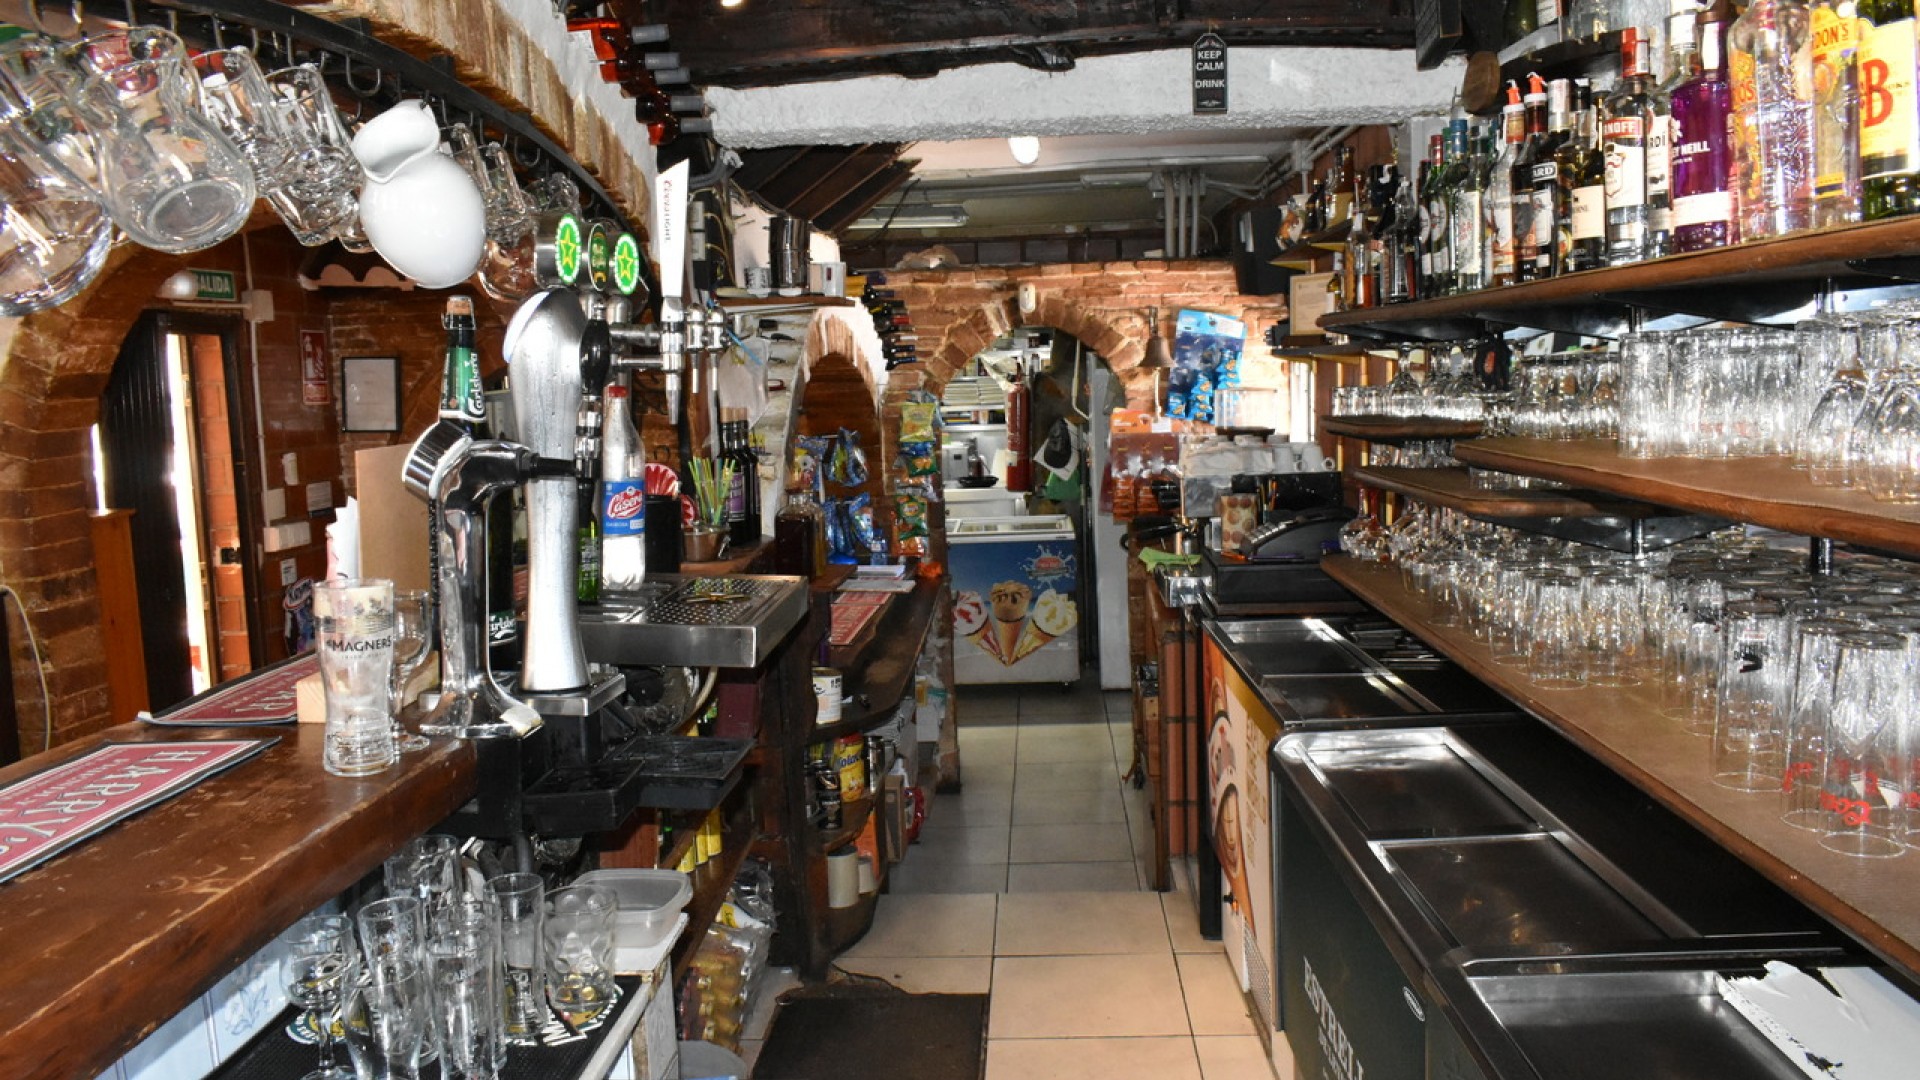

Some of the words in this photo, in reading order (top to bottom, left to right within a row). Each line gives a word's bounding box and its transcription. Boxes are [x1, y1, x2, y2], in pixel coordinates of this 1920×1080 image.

[1197, 50, 1222, 59] KEEP
[1196, 62, 1225, 71] CALM
[1194, 80, 1225, 88] DRINK
[1605, 121, 1635, 135] NOFF
[198, 273, 232, 294] ALIDA
[466, 351, 485, 415] Carlsberg
[332, 635, 392, 652] MAGNERS
[0, 749, 211, 855] HARRY'
